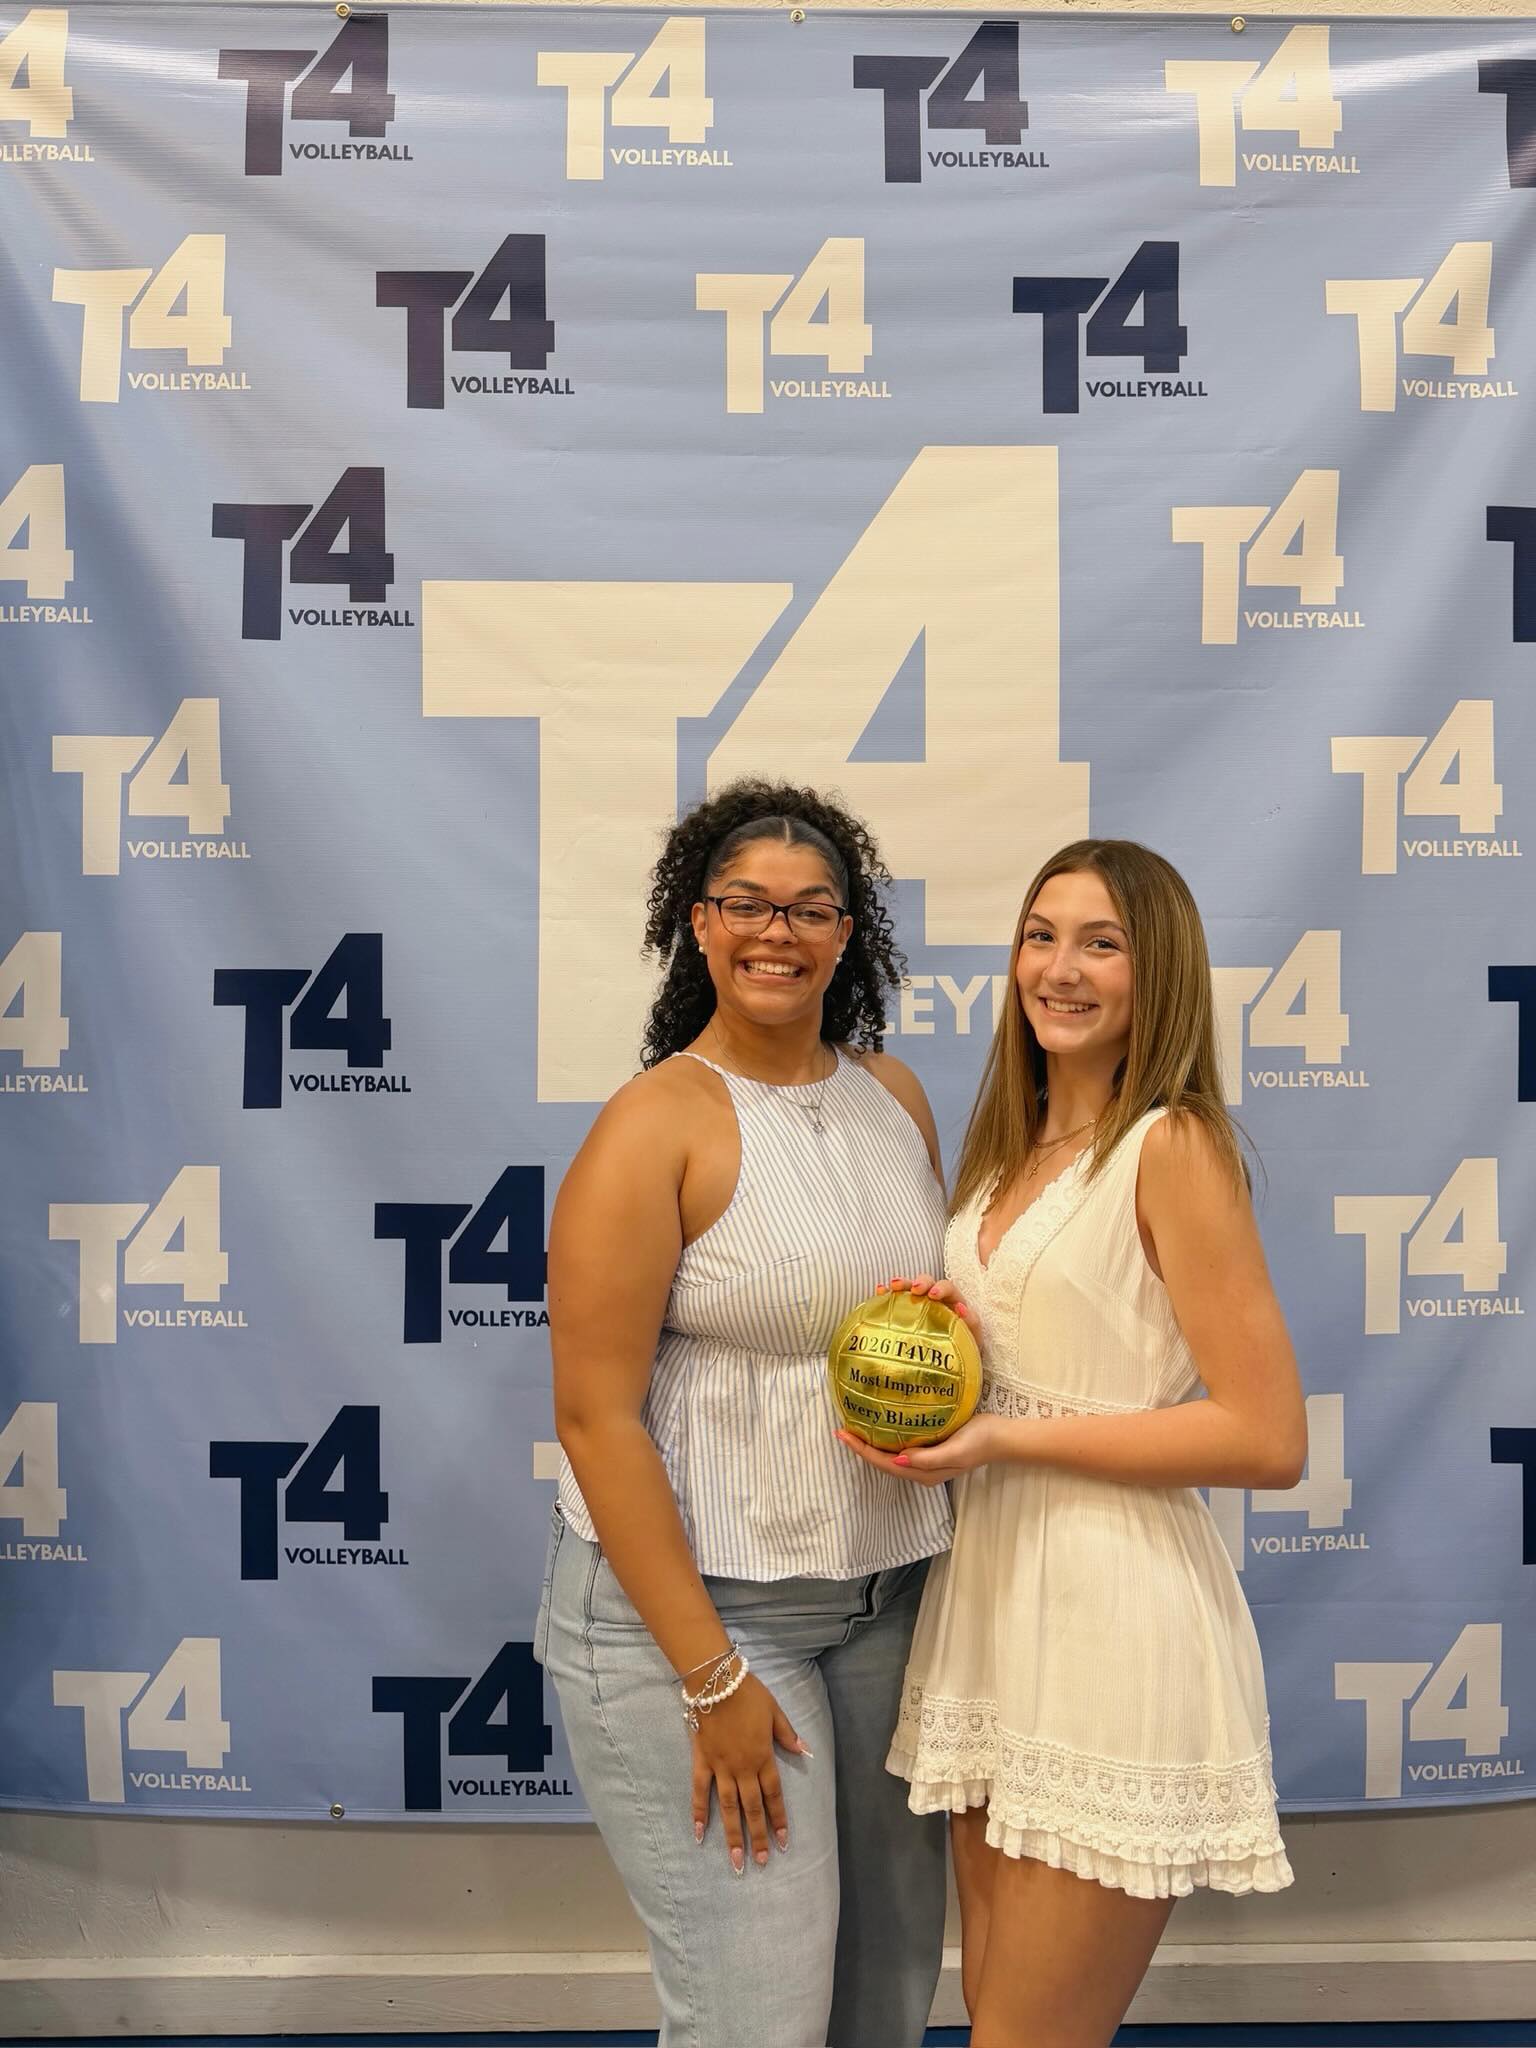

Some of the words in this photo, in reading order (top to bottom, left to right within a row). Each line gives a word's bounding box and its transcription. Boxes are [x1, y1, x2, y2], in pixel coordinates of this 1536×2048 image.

[0, 9, 73, 137] 4
[218, 13, 395, 175] T4
[537, 17, 713, 179] T4
[853, 21, 1029, 183] T4
[1165, 25, 1342, 187] T4
[0, 144, 94, 162] LLEYBALL
[290, 143, 413, 161] VOLLEYBALL
[610, 149, 733, 166] VOLLEYBALL
[928, 151, 1049, 168] VOLLEYBALL
[1242, 154, 1360, 174] VOLLEYBALL
[53, 234, 232, 402] T4
[376, 234, 555, 409] T4
[696, 238, 872, 413] T4
[1013, 241, 1188, 414] T4
[1325, 242, 1495, 412] T4
[128, 372, 250, 390] VOLLEYBALL
[452, 377, 574, 395] VOLLEYBALL
[770, 381, 891, 398] VOLLEYBALL
[1086, 380, 1207, 398] VOLLEYBALL
[1403, 379, 1518, 399] VOLLEYBALL
[0, 464, 74, 599] 4
[212, 467, 394, 640] T4
[1172, 469, 1344, 645] T4
[0, 606, 93, 623] LLEYBALL
[289, 609, 414, 627] VOLLEYBALL
[1245, 611, 1364, 628] VOLLEYBALL
[52, 698, 231, 875] T4
[422, 445, 1090, 1103] T4
[1331, 700, 1503, 874] T4
[127, 841, 250, 859] VOLLEYBALL
[1403, 840, 1522, 858] VOLLEYBALL
[0, 932, 69, 1068] 4
[213, 933, 392, 1109] T4
[0, 1075, 88, 1093] LEYBALL
[289, 1075, 411, 1093] VOLLEYBALL
[1249, 1071, 1369, 1088] VOLLEYBALL
[48, 1166, 228, 1344] T4
[374, 1166, 548, 1344] T4
[1334, 1158, 1507, 1335] T4
[124, 1310, 248, 1328] VOLLEYBALL
[449, 1310, 550, 1327] VOLLEYBA
[1406, 1297, 1524, 1318] VOLLEYBALL
[848, 1335, 891, 1354] 2026
[895, 1340, 954, 1371] T4VBC
[850, 1368, 880, 1388] Most
[884, 1375, 954, 1397] Improved
[843, 1395, 882, 1424] Avery
[886, 1409, 945, 1427] Blaikie
[0, 1402, 66, 1537] 4
[209, 1405, 389, 1580] T4
[0, 1544, 87, 1562] LEYBALL
[285, 1547, 409, 1566] VOLLEYBALL
[1251, 1533, 1369, 1553] VOLLEYBALL
[53, 1638, 230, 1803] T4
[1334, 1623, 1508, 1798] T4
[372, 1642, 552, 1812] T4
[130, 1772, 251, 1791] VOLLEYBALL
[1409, 1760, 1524, 1781] VOLLEYBALL
[448, 1780, 572, 1795] VOLLEYBALL
